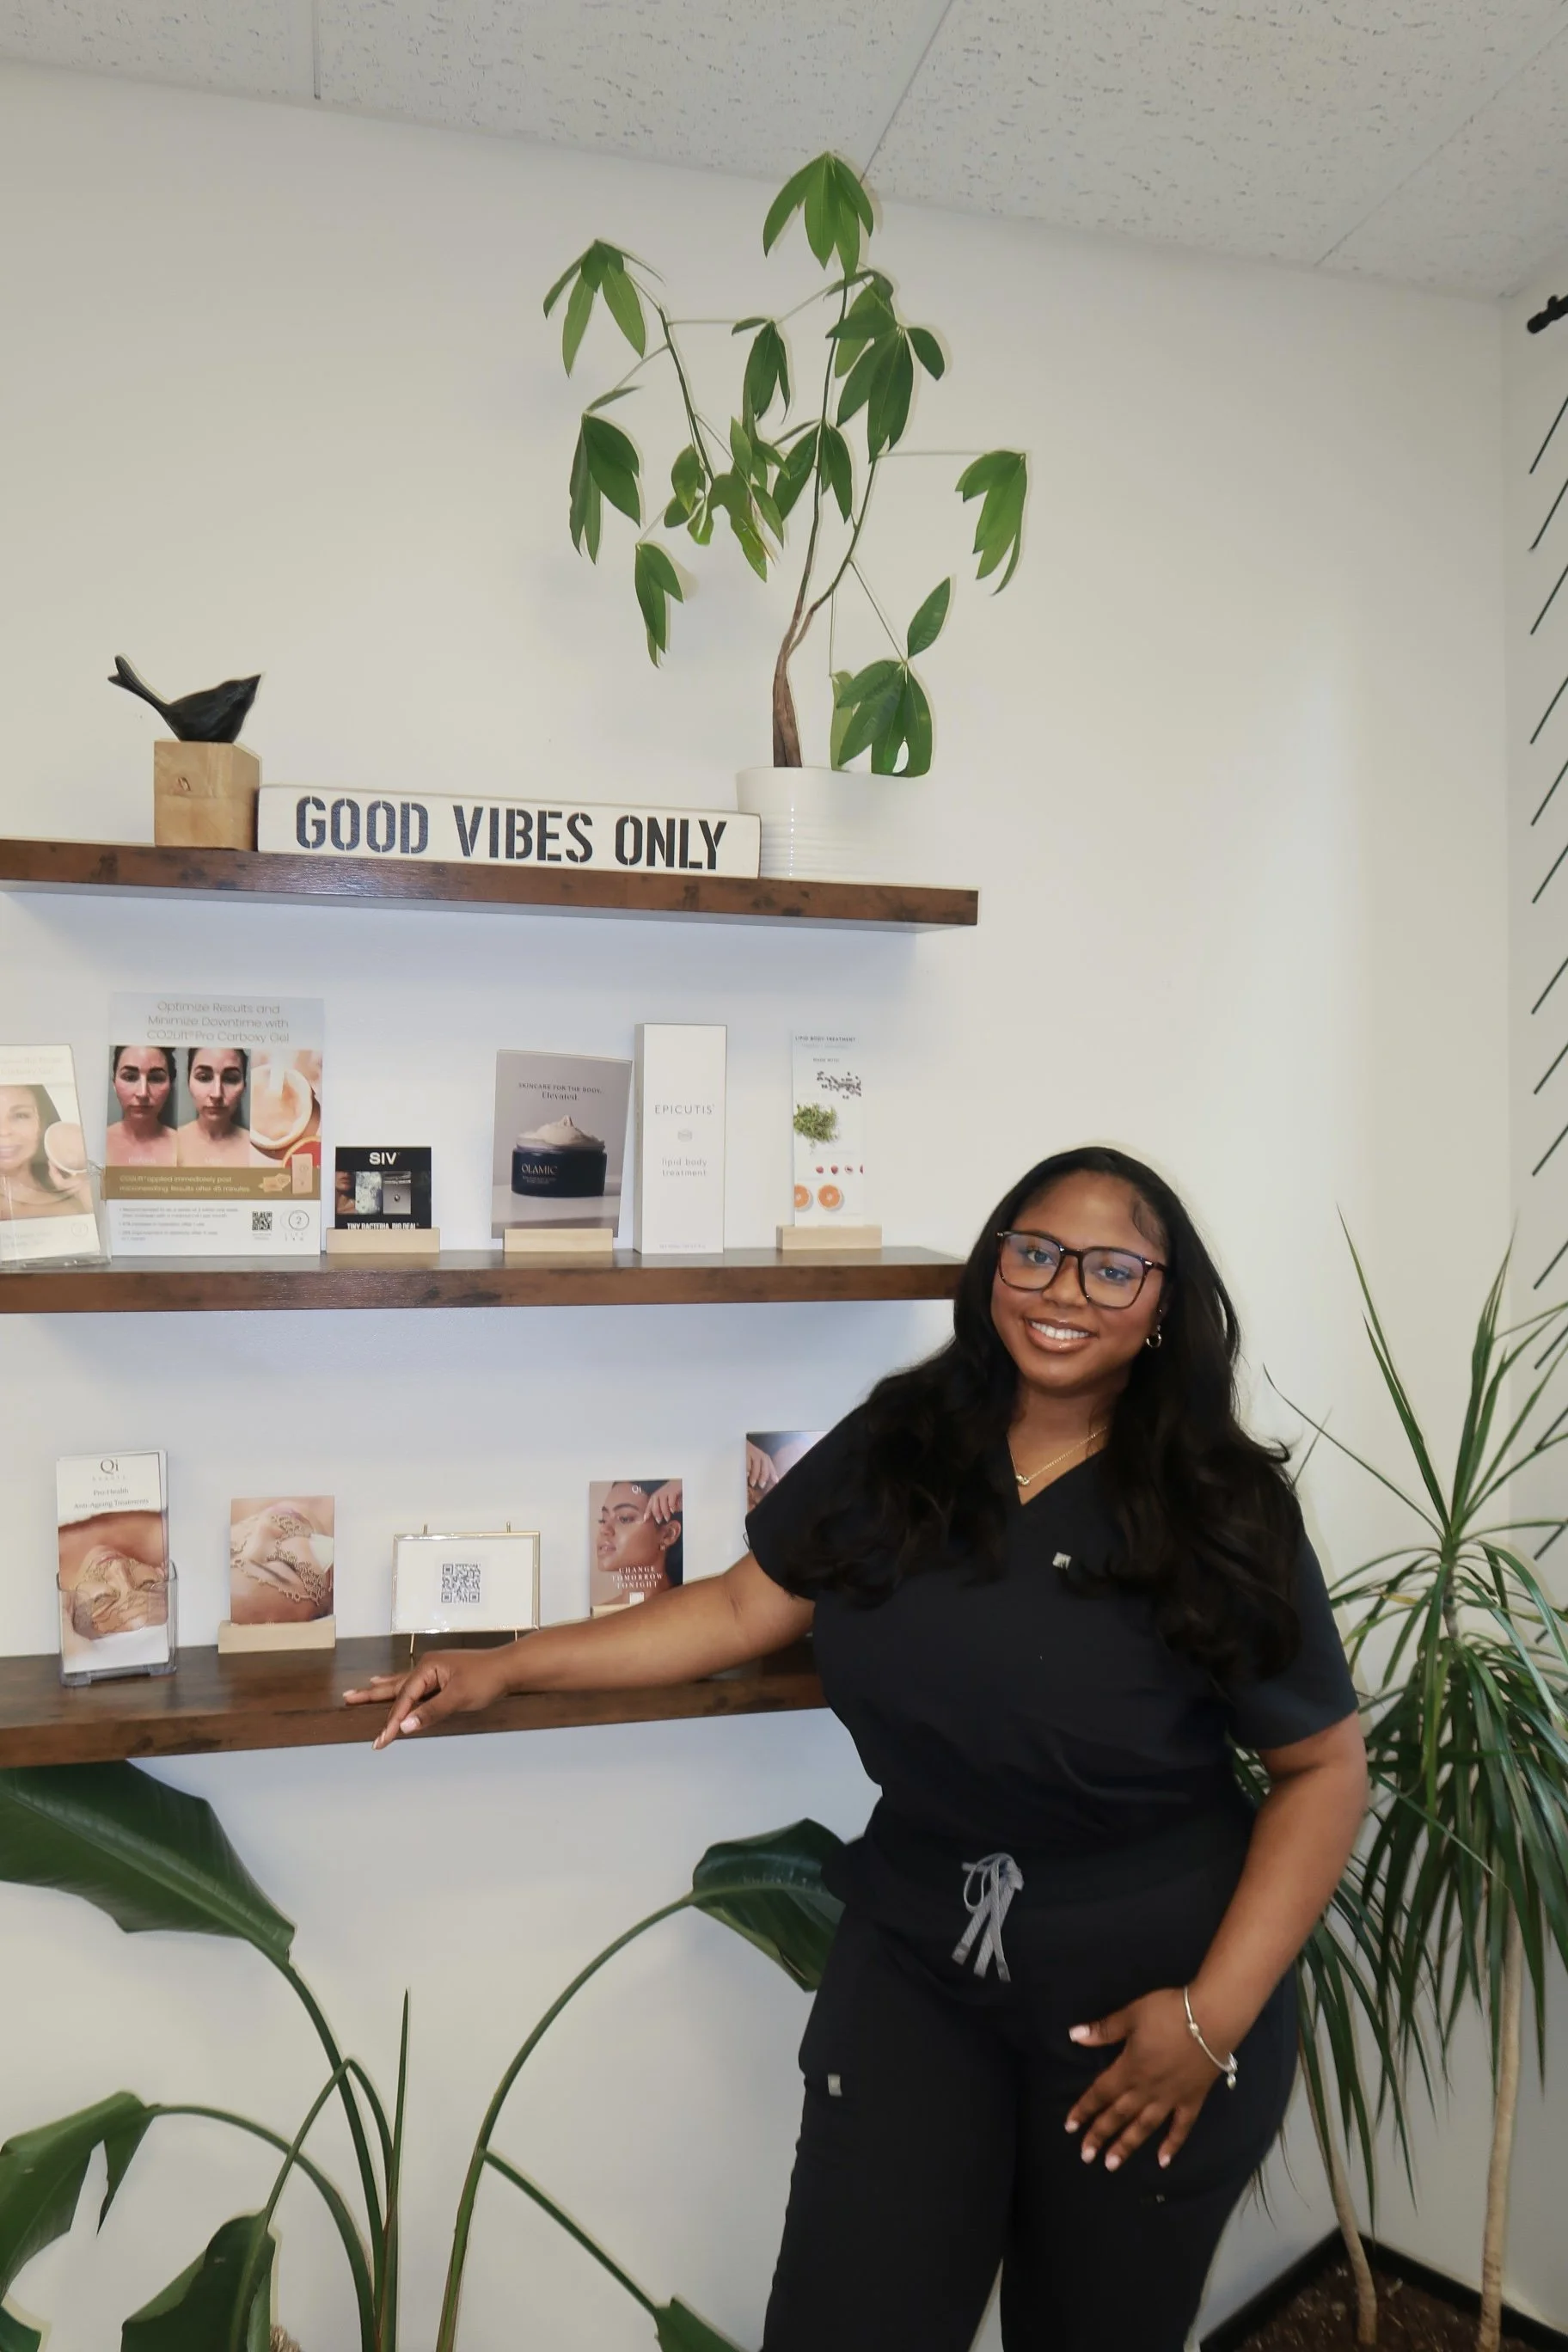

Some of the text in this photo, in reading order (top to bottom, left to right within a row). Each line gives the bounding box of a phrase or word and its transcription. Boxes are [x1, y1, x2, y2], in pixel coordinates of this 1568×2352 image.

[295, 795, 728, 871] GOOD VIBES ONLY
[157, 1000, 280, 1014] Optimize Results and
[148, 1015, 290, 1028] Minimize Downtime with
[195, 1030, 214, 1040] Pro
[217, 1031, 266, 1044] Carboxy
[270, 1032, 290, 1043] Gel
[518, 1082, 551, 1091] SKINCARE
[369, 1152, 397, 1165] SIV
[662, 1157, 707, 1167] lipid body
[521, 1163, 558, 1175] OLAMIC
[101, 1458, 119, 1475] Qi
[113, 1498, 150, 1507] Treatments
[619, 1565, 656, 1574] CHANGE
[612, 1573, 663, 1582] TOMORROW
[617, 1581, 658, 1589] TONIGHT
